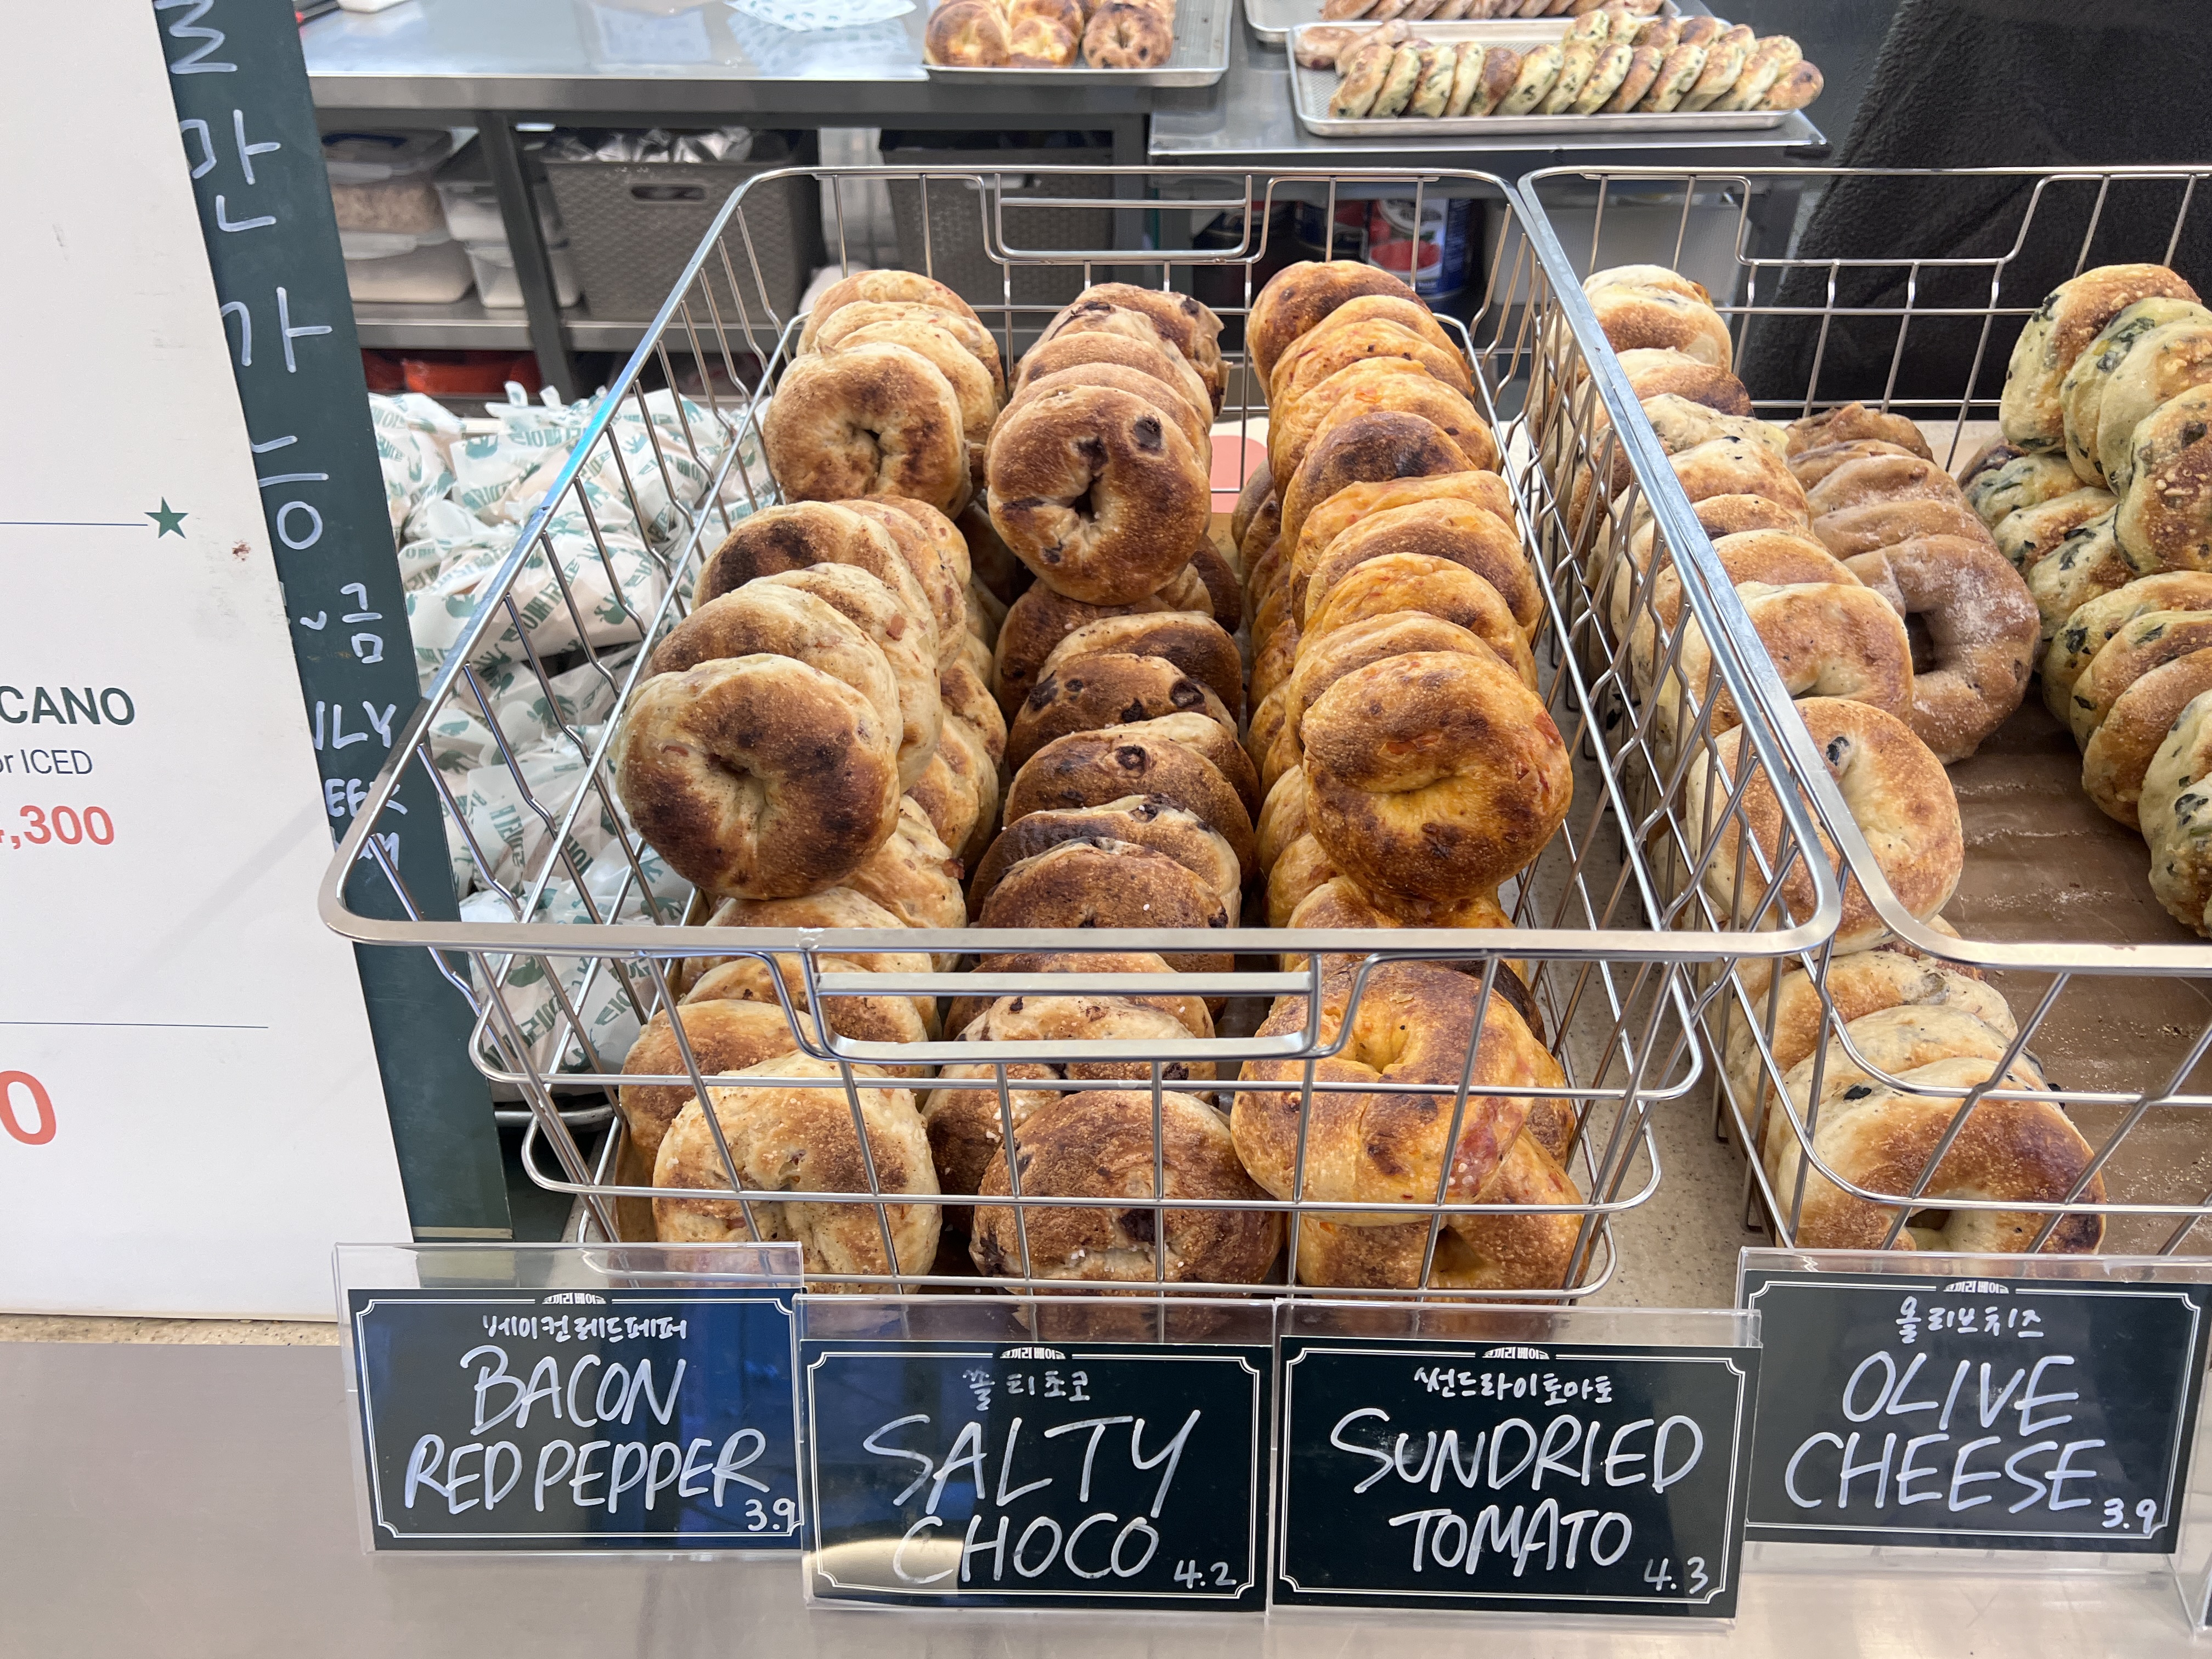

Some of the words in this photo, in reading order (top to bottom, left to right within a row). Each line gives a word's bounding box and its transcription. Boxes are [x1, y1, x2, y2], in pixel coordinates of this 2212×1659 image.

[0, 686, 135, 725] CANO
[20, 749, 93, 774] ICED
[0, 804, 115, 849] ,300
[460, 1345, 686, 1435] BACON
[1842, 1350, 2080, 1437] OLIVE
[404, 1434, 523, 1514] RED
[534, 1428, 770, 1514] PEPPER
[863, 1409, 1201, 1518] SALTY
[1330, 1408, 1703, 1493] SUNDRIED
[1784, 1431, 2106, 1513] CHEESE
[744, 1498, 795, 1532] 3.9
[893, 1513, 1160, 1584] CHOCO
[1389, 1498, 1632, 1577] TOMATO
[2101, 1498, 2158, 1534] 3.9
[1173, 1559, 1237, 1589] 4.2
[1643, 1556, 1709, 1595] 4.3
